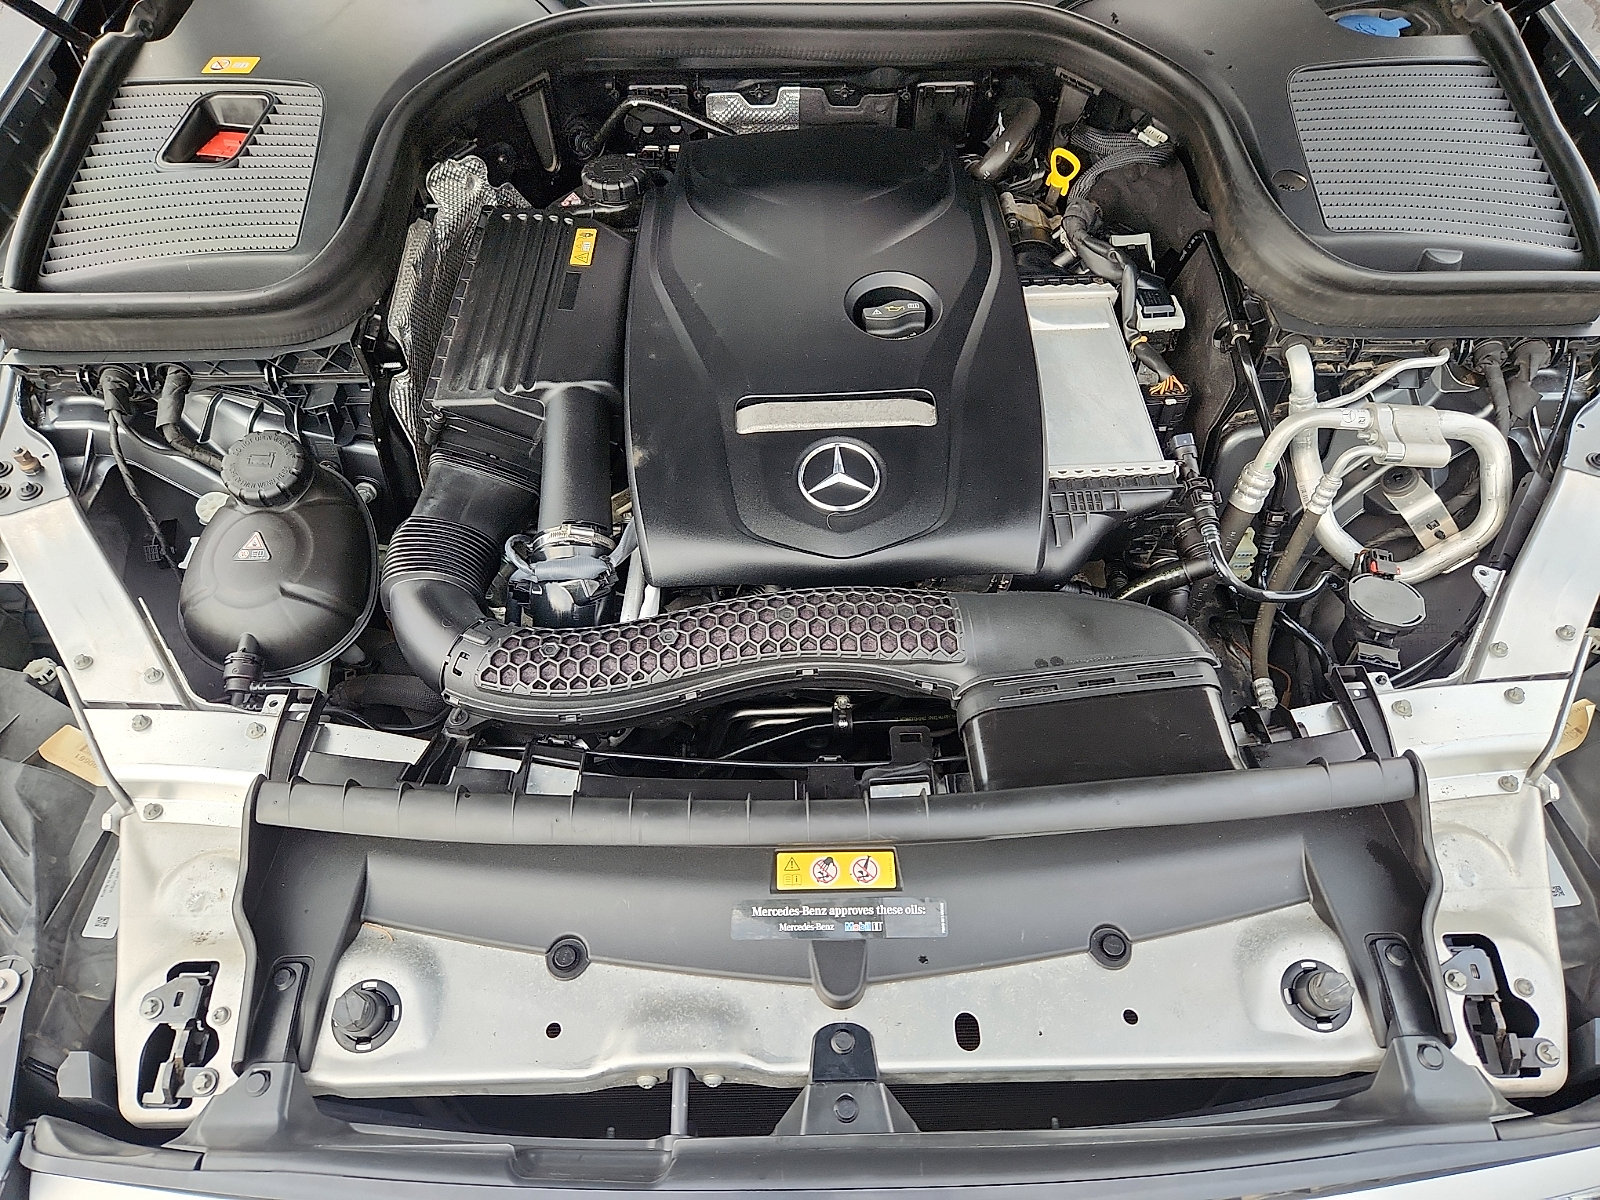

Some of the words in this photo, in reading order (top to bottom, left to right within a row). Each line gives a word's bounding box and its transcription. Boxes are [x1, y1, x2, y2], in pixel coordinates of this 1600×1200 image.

[752, 906, 827, 917] Mercedes-Benz
[829, 907, 874, 918] approves
[876, 905, 903, 915] these
[905, 905, 926, 915] oils:
[779, 922, 835, 932] Mercedes-Benz
[844, 922, 871, 931] Mobil
